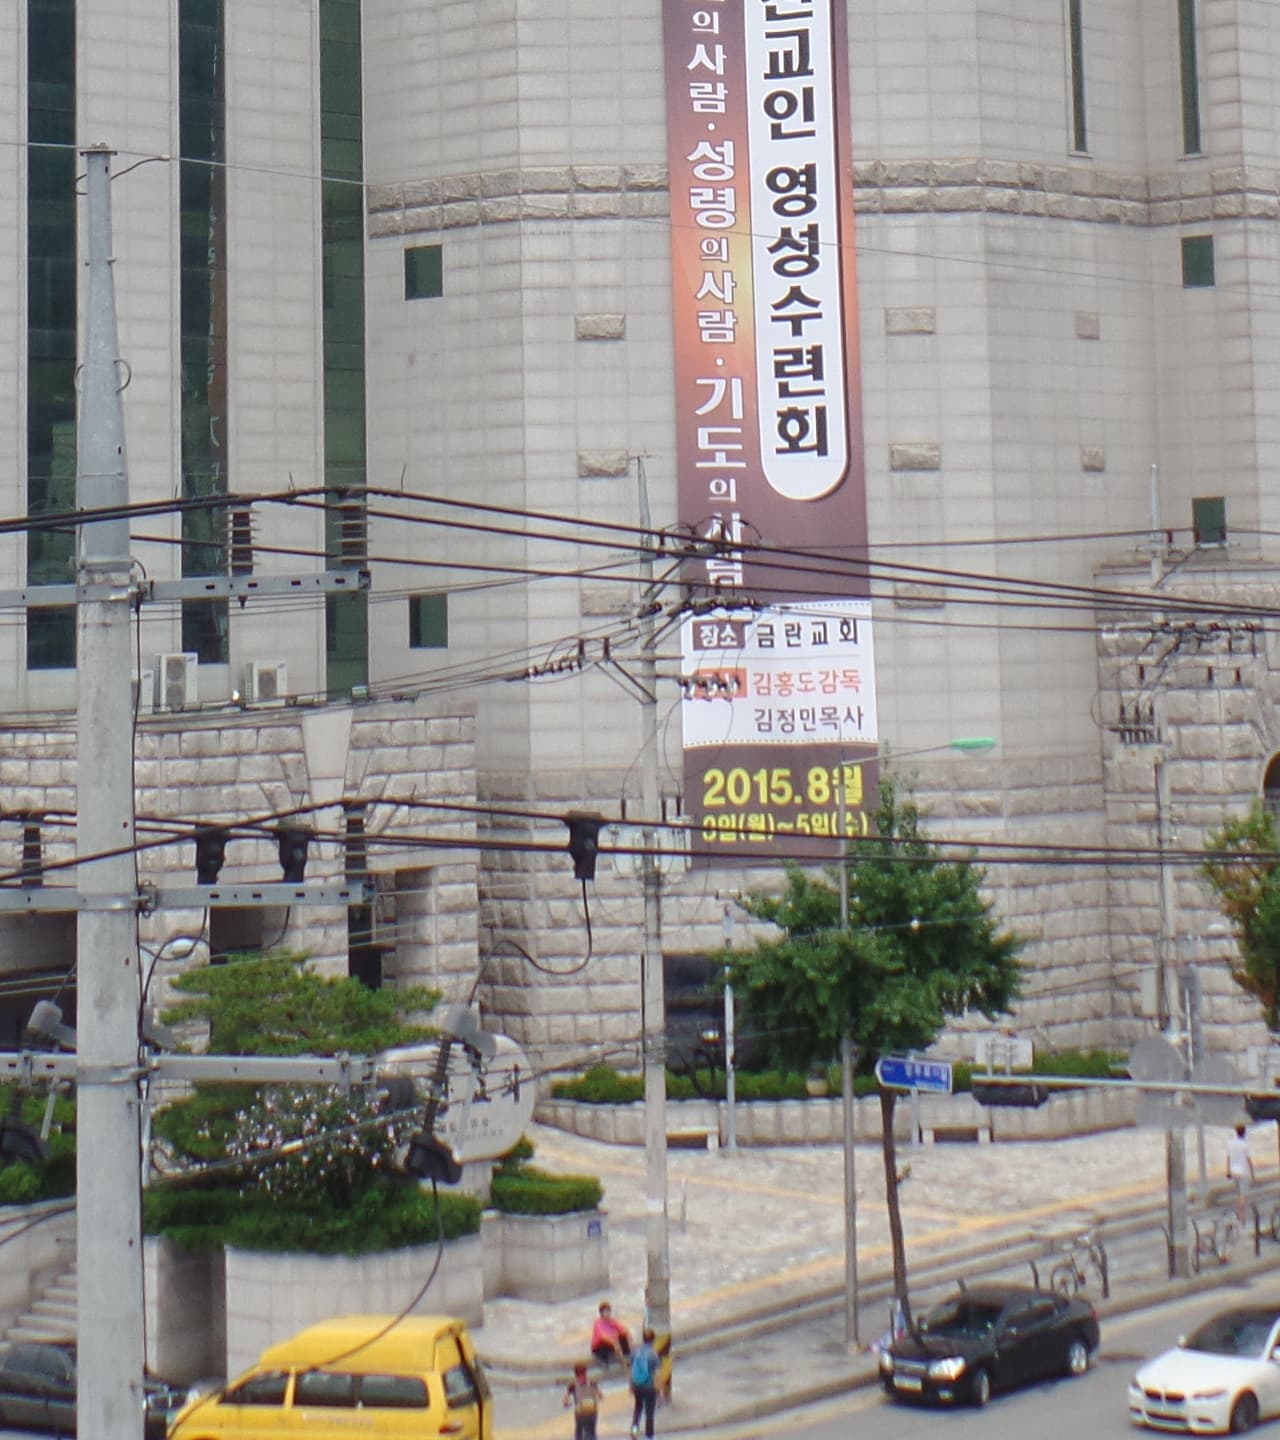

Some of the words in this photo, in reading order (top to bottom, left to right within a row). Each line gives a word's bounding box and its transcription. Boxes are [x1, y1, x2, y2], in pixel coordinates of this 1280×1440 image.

[687, 44, 727, 113] 사람
[687, 140, 737, 263] 성령의
[694, 271, 737, 344] 사람
[695, 377, 746, 502] 기도의
[699, 624, 738, 648] 장소
[757, 618, 858, 649] 금란교회
